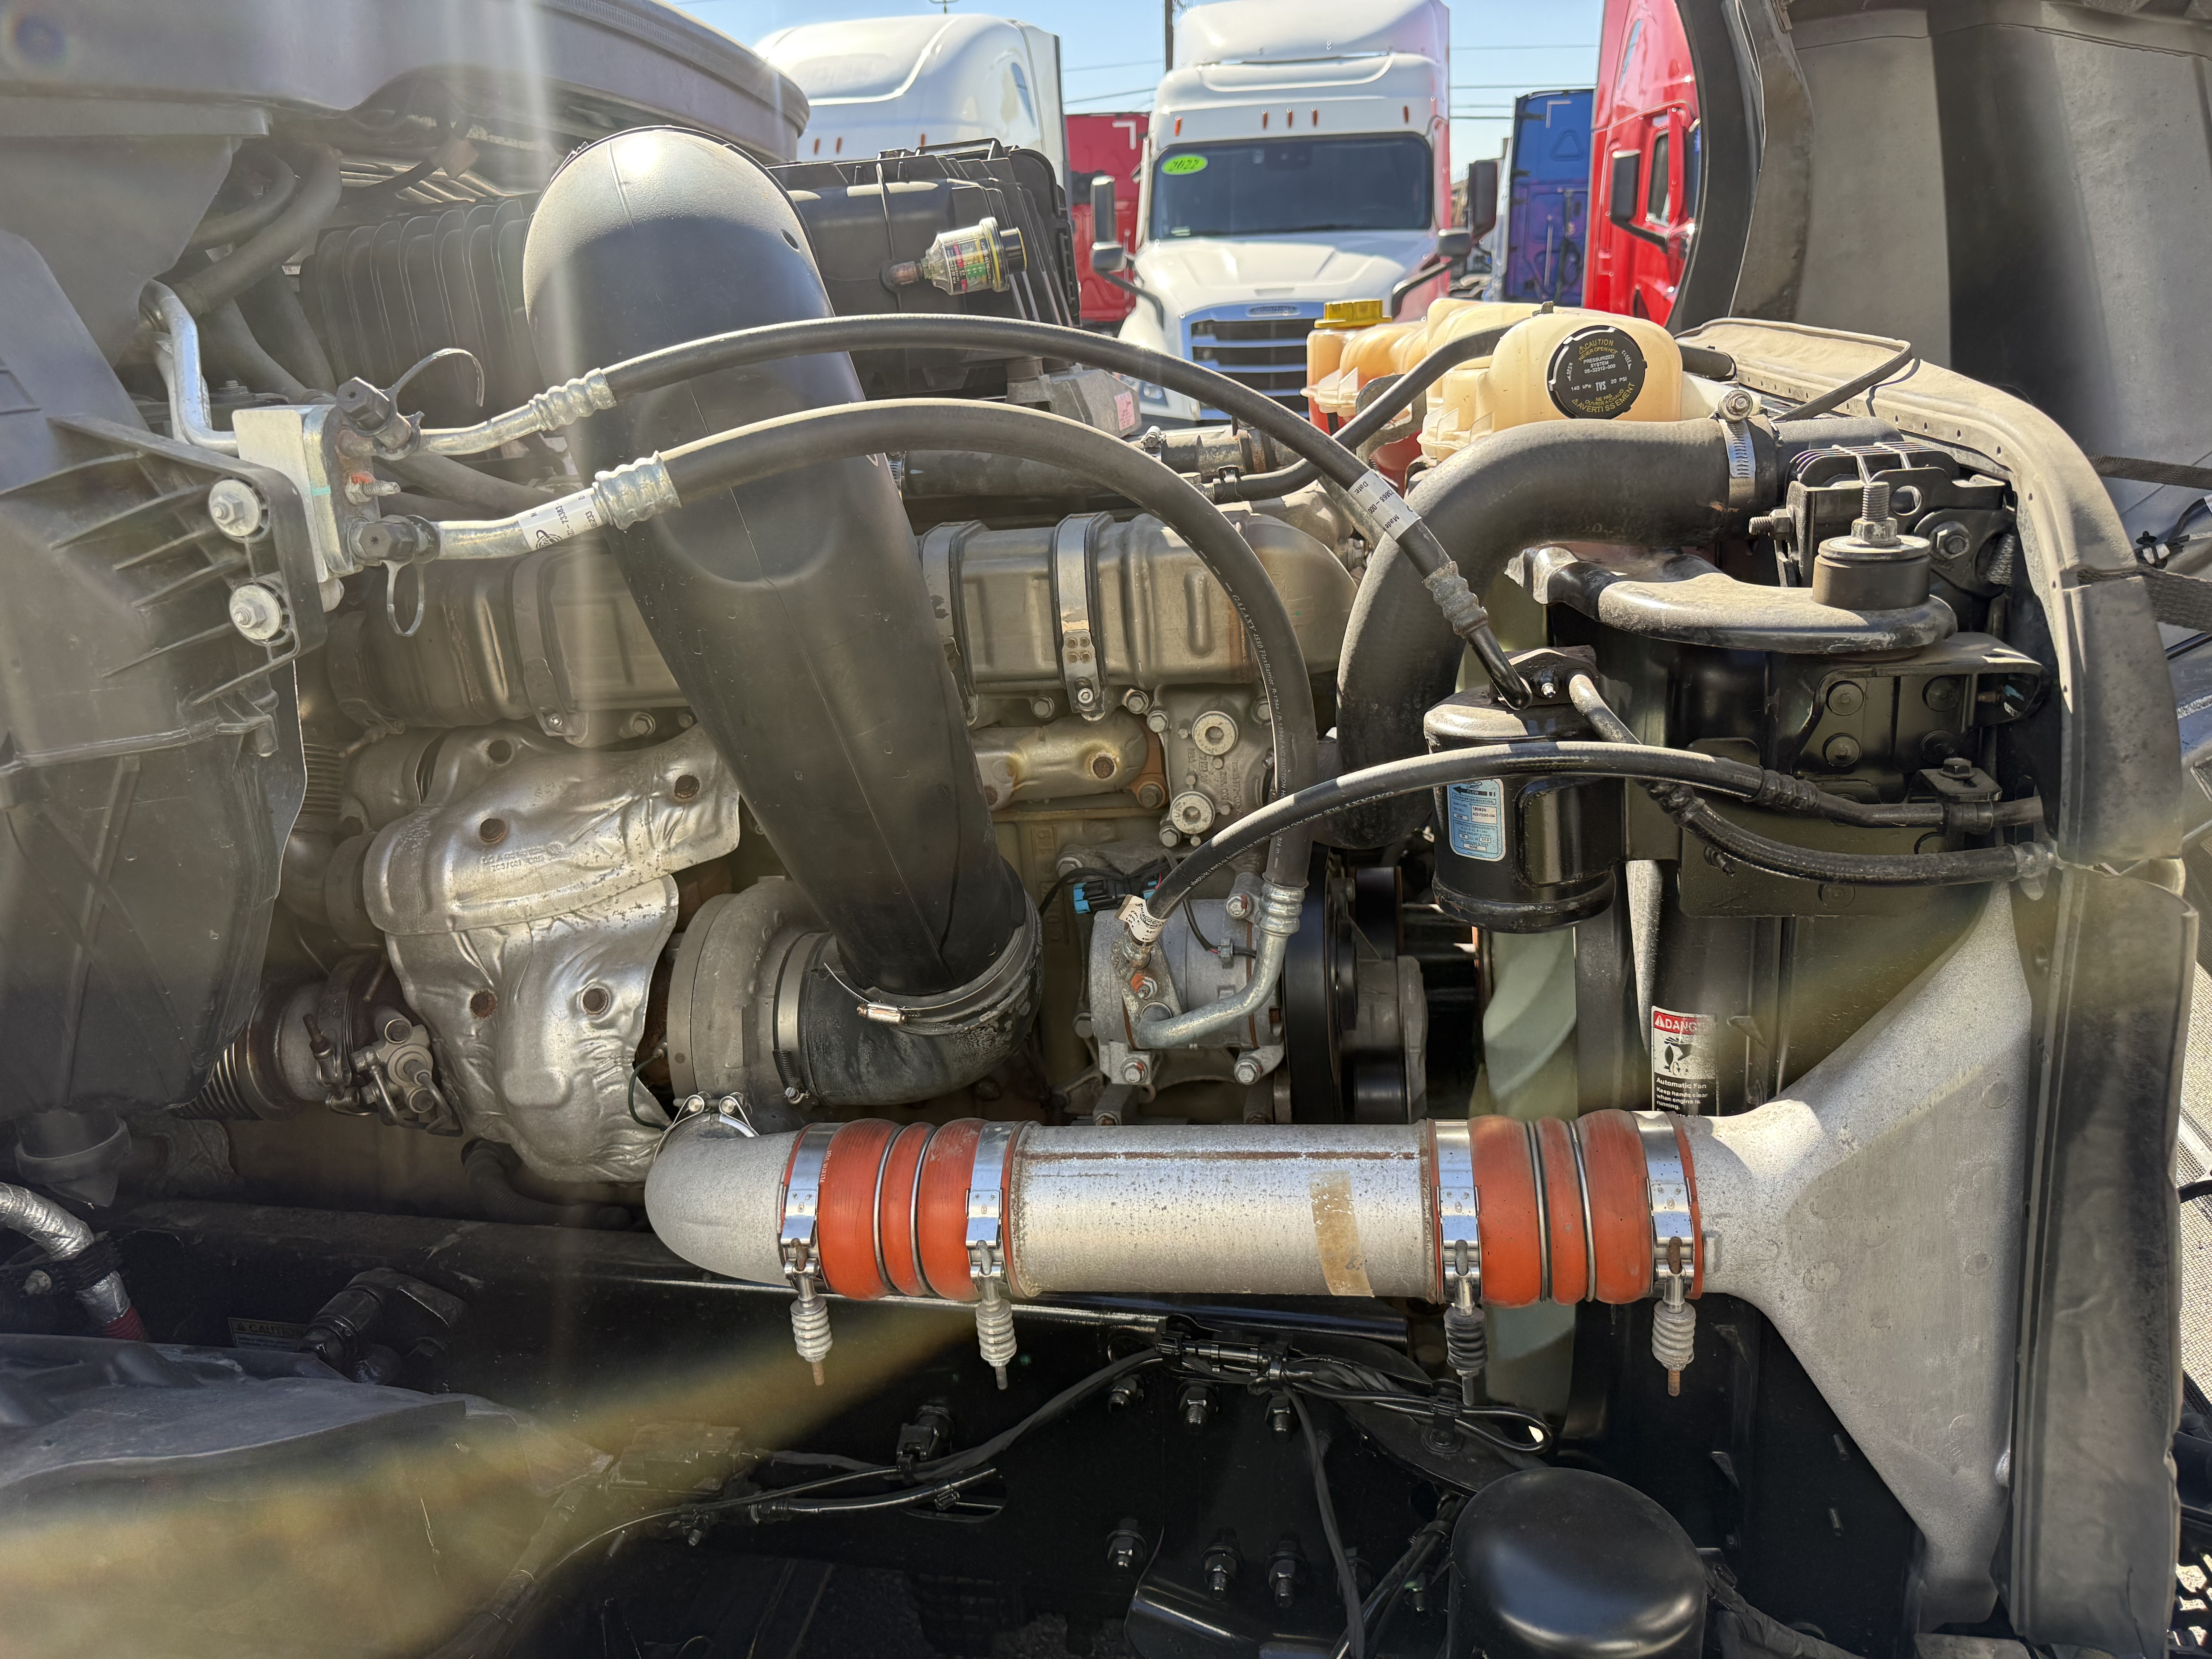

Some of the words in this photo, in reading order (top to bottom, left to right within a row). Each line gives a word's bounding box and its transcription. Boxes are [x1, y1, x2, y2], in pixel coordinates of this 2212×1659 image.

[1585, 339, 1614, 349] CAUTION
[1578, 350, 1594, 361] NEVER
[1583, 354, 1615, 364] PRESSURIZED
[1621, 350, 1632, 364] CLOSE
[1584, 364, 1616, 374] 05-32312-000
[1595, 381, 1606, 391] TVS
[1608, 389, 1624, 404] CHAUD
[1354, 481, 1369, 495] Date:
[1385, 514, 1400, 529] Made
[1232, 595, 1256, 632] GALAXY
[1253, 633, 1264, 649] 4880
[1259, 650, 1274, 685] FlexBarrier
[1271, 688, 1279, 710] R-134a
[1656, 1077, 1691, 1089] Automatic
[1656, 1087, 1670, 1095] Keep
[1656, 1101, 1680, 1110] running.
